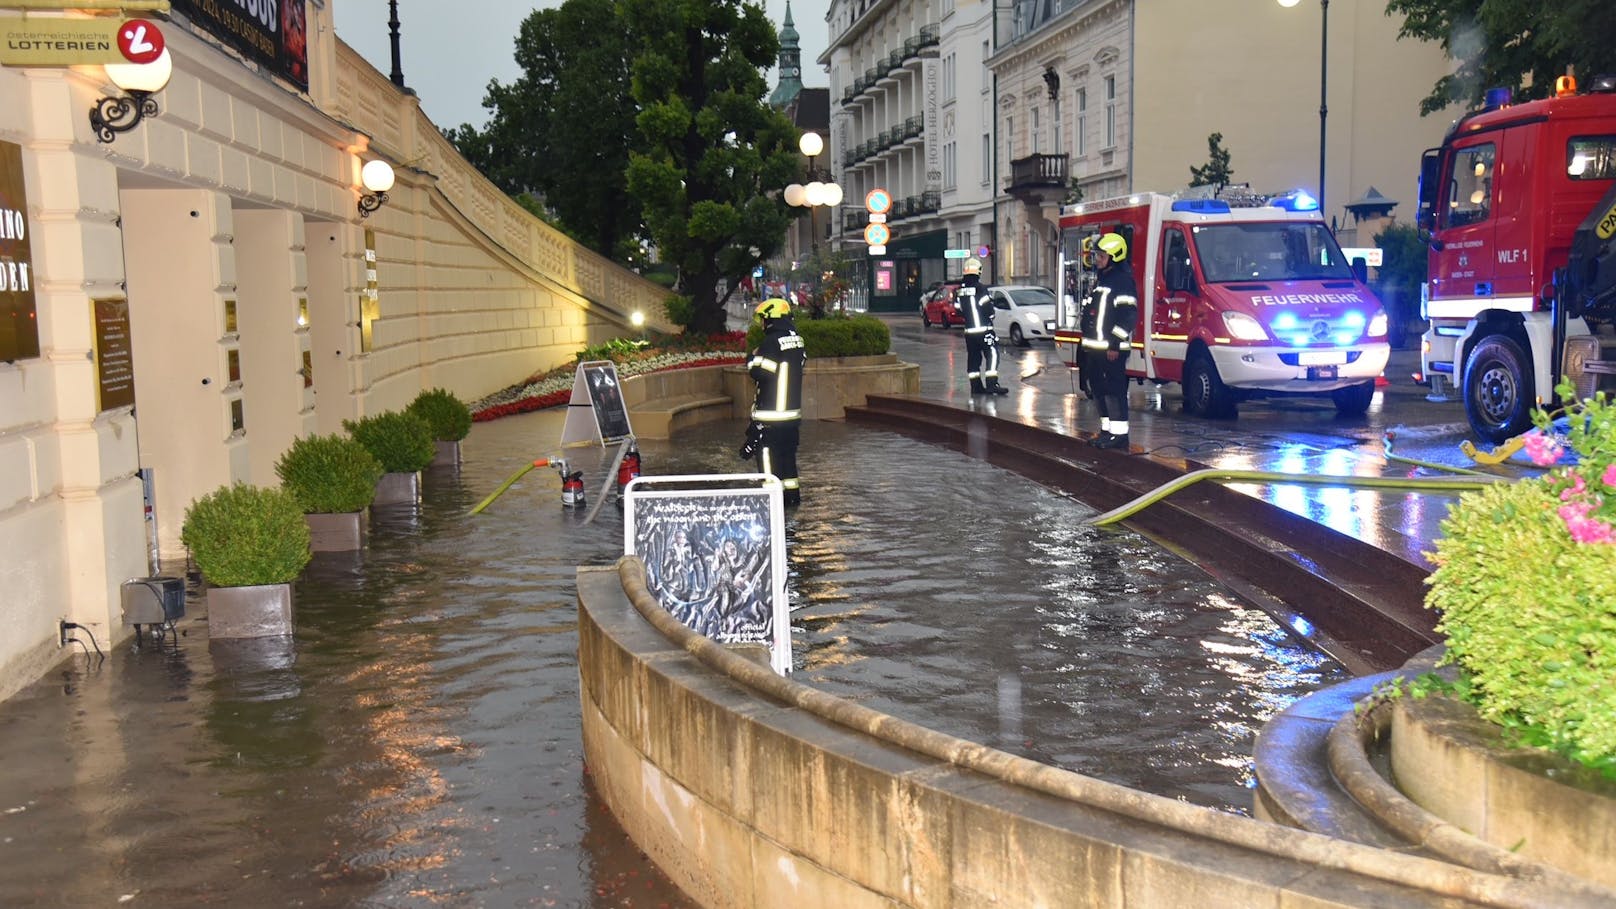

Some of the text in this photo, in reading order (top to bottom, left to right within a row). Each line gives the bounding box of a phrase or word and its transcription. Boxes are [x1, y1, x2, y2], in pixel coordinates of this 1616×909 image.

[8, 40, 110, 51] LOTTERIEN
[928, 131, 938, 165] HOTEL
[1497, 248, 1528, 264] WLF 1
[1251, 293, 1363, 306] FEUERWEHR
